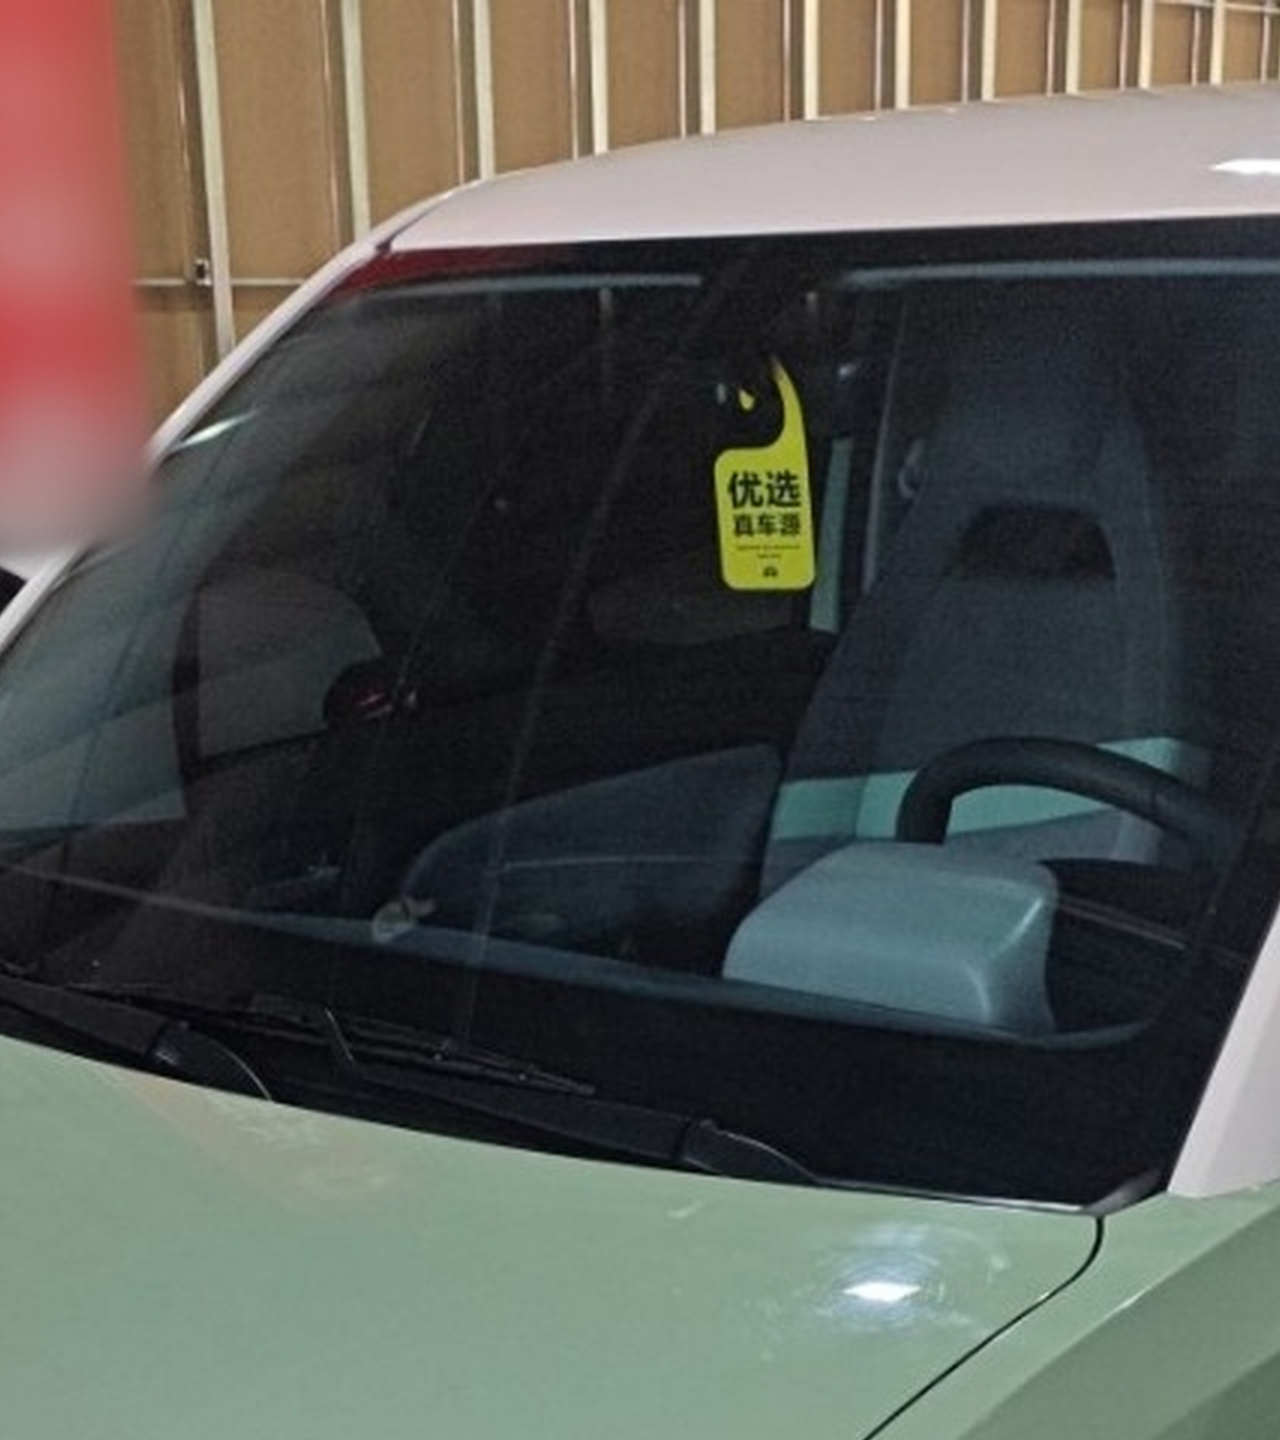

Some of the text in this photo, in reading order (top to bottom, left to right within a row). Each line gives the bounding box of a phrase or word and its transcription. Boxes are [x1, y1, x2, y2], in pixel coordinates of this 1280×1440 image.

[728, 470, 802, 508] 优选
[734, 513, 801, 537] 真车源
